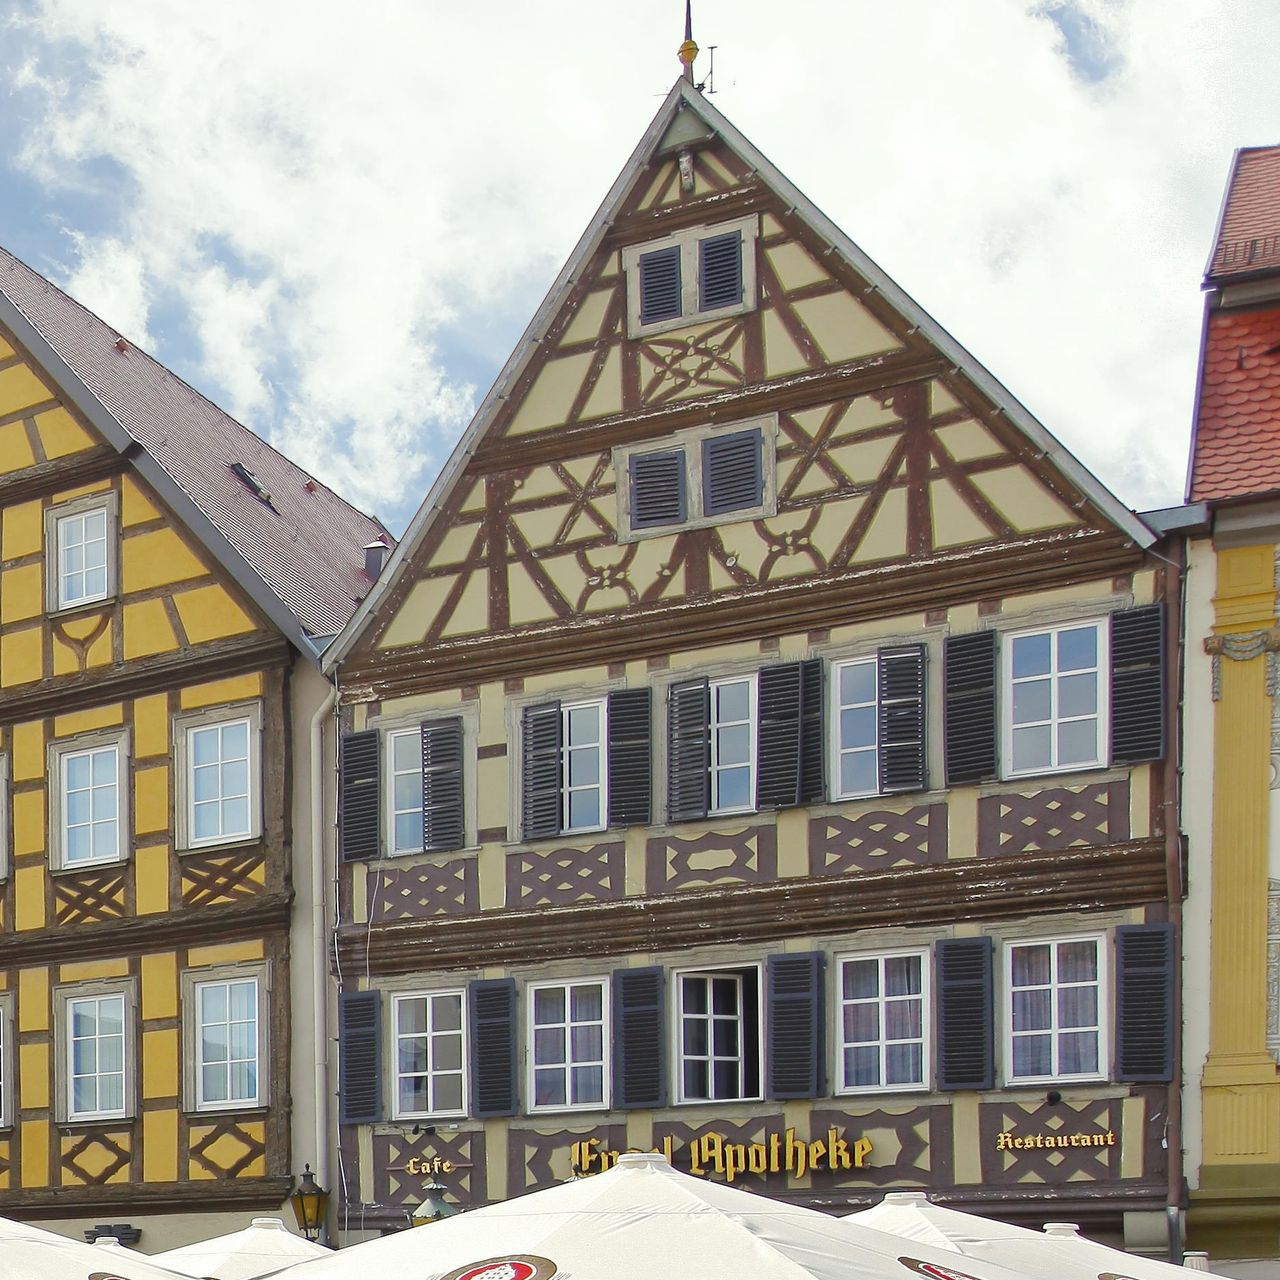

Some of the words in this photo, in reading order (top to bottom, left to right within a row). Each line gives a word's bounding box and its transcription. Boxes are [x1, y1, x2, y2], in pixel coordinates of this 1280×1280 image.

[996, 1130, 1115, 1151] Restaurant
[690, 1127, 873, 1182] Apotheke
[406, 1156, 452, 1175] Cafe
